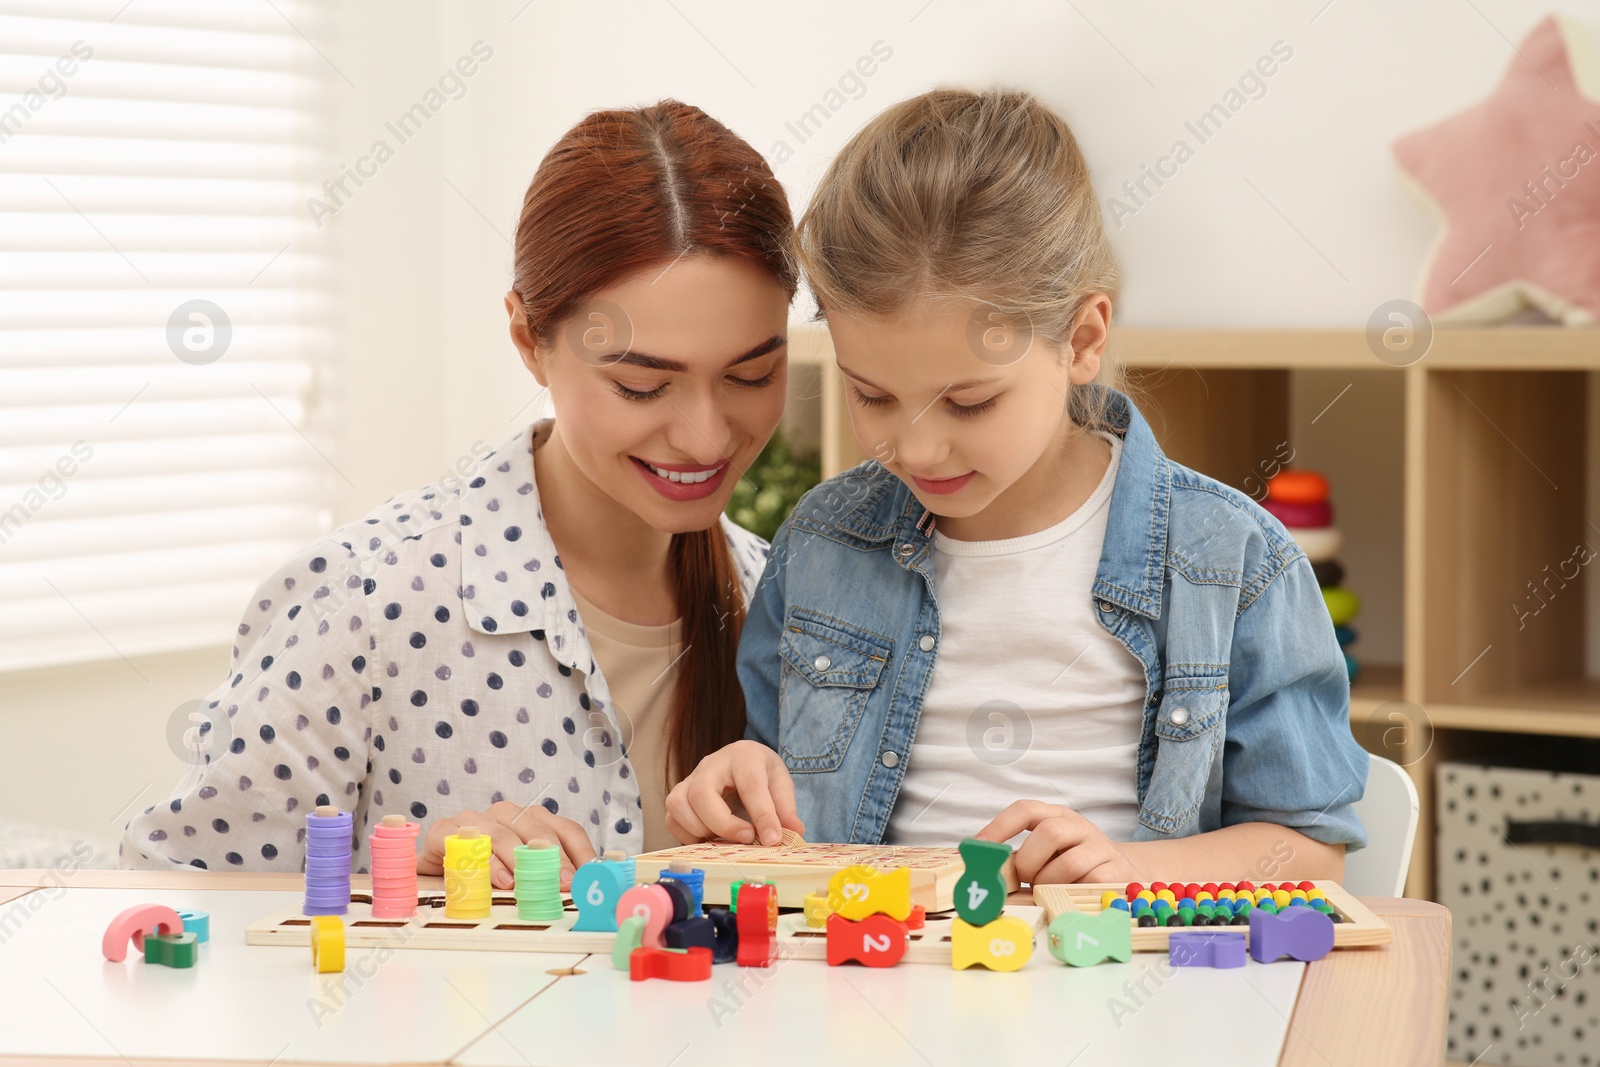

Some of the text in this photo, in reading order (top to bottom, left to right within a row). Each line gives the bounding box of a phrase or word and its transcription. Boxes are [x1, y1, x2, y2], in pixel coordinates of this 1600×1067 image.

[586, 880, 605, 906] 6
[967, 880, 989, 910] 4
[863, 933, 891, 953] 2
[989, 937, 1016, 958] 8
[1076, 931, 1100, 950] 7
